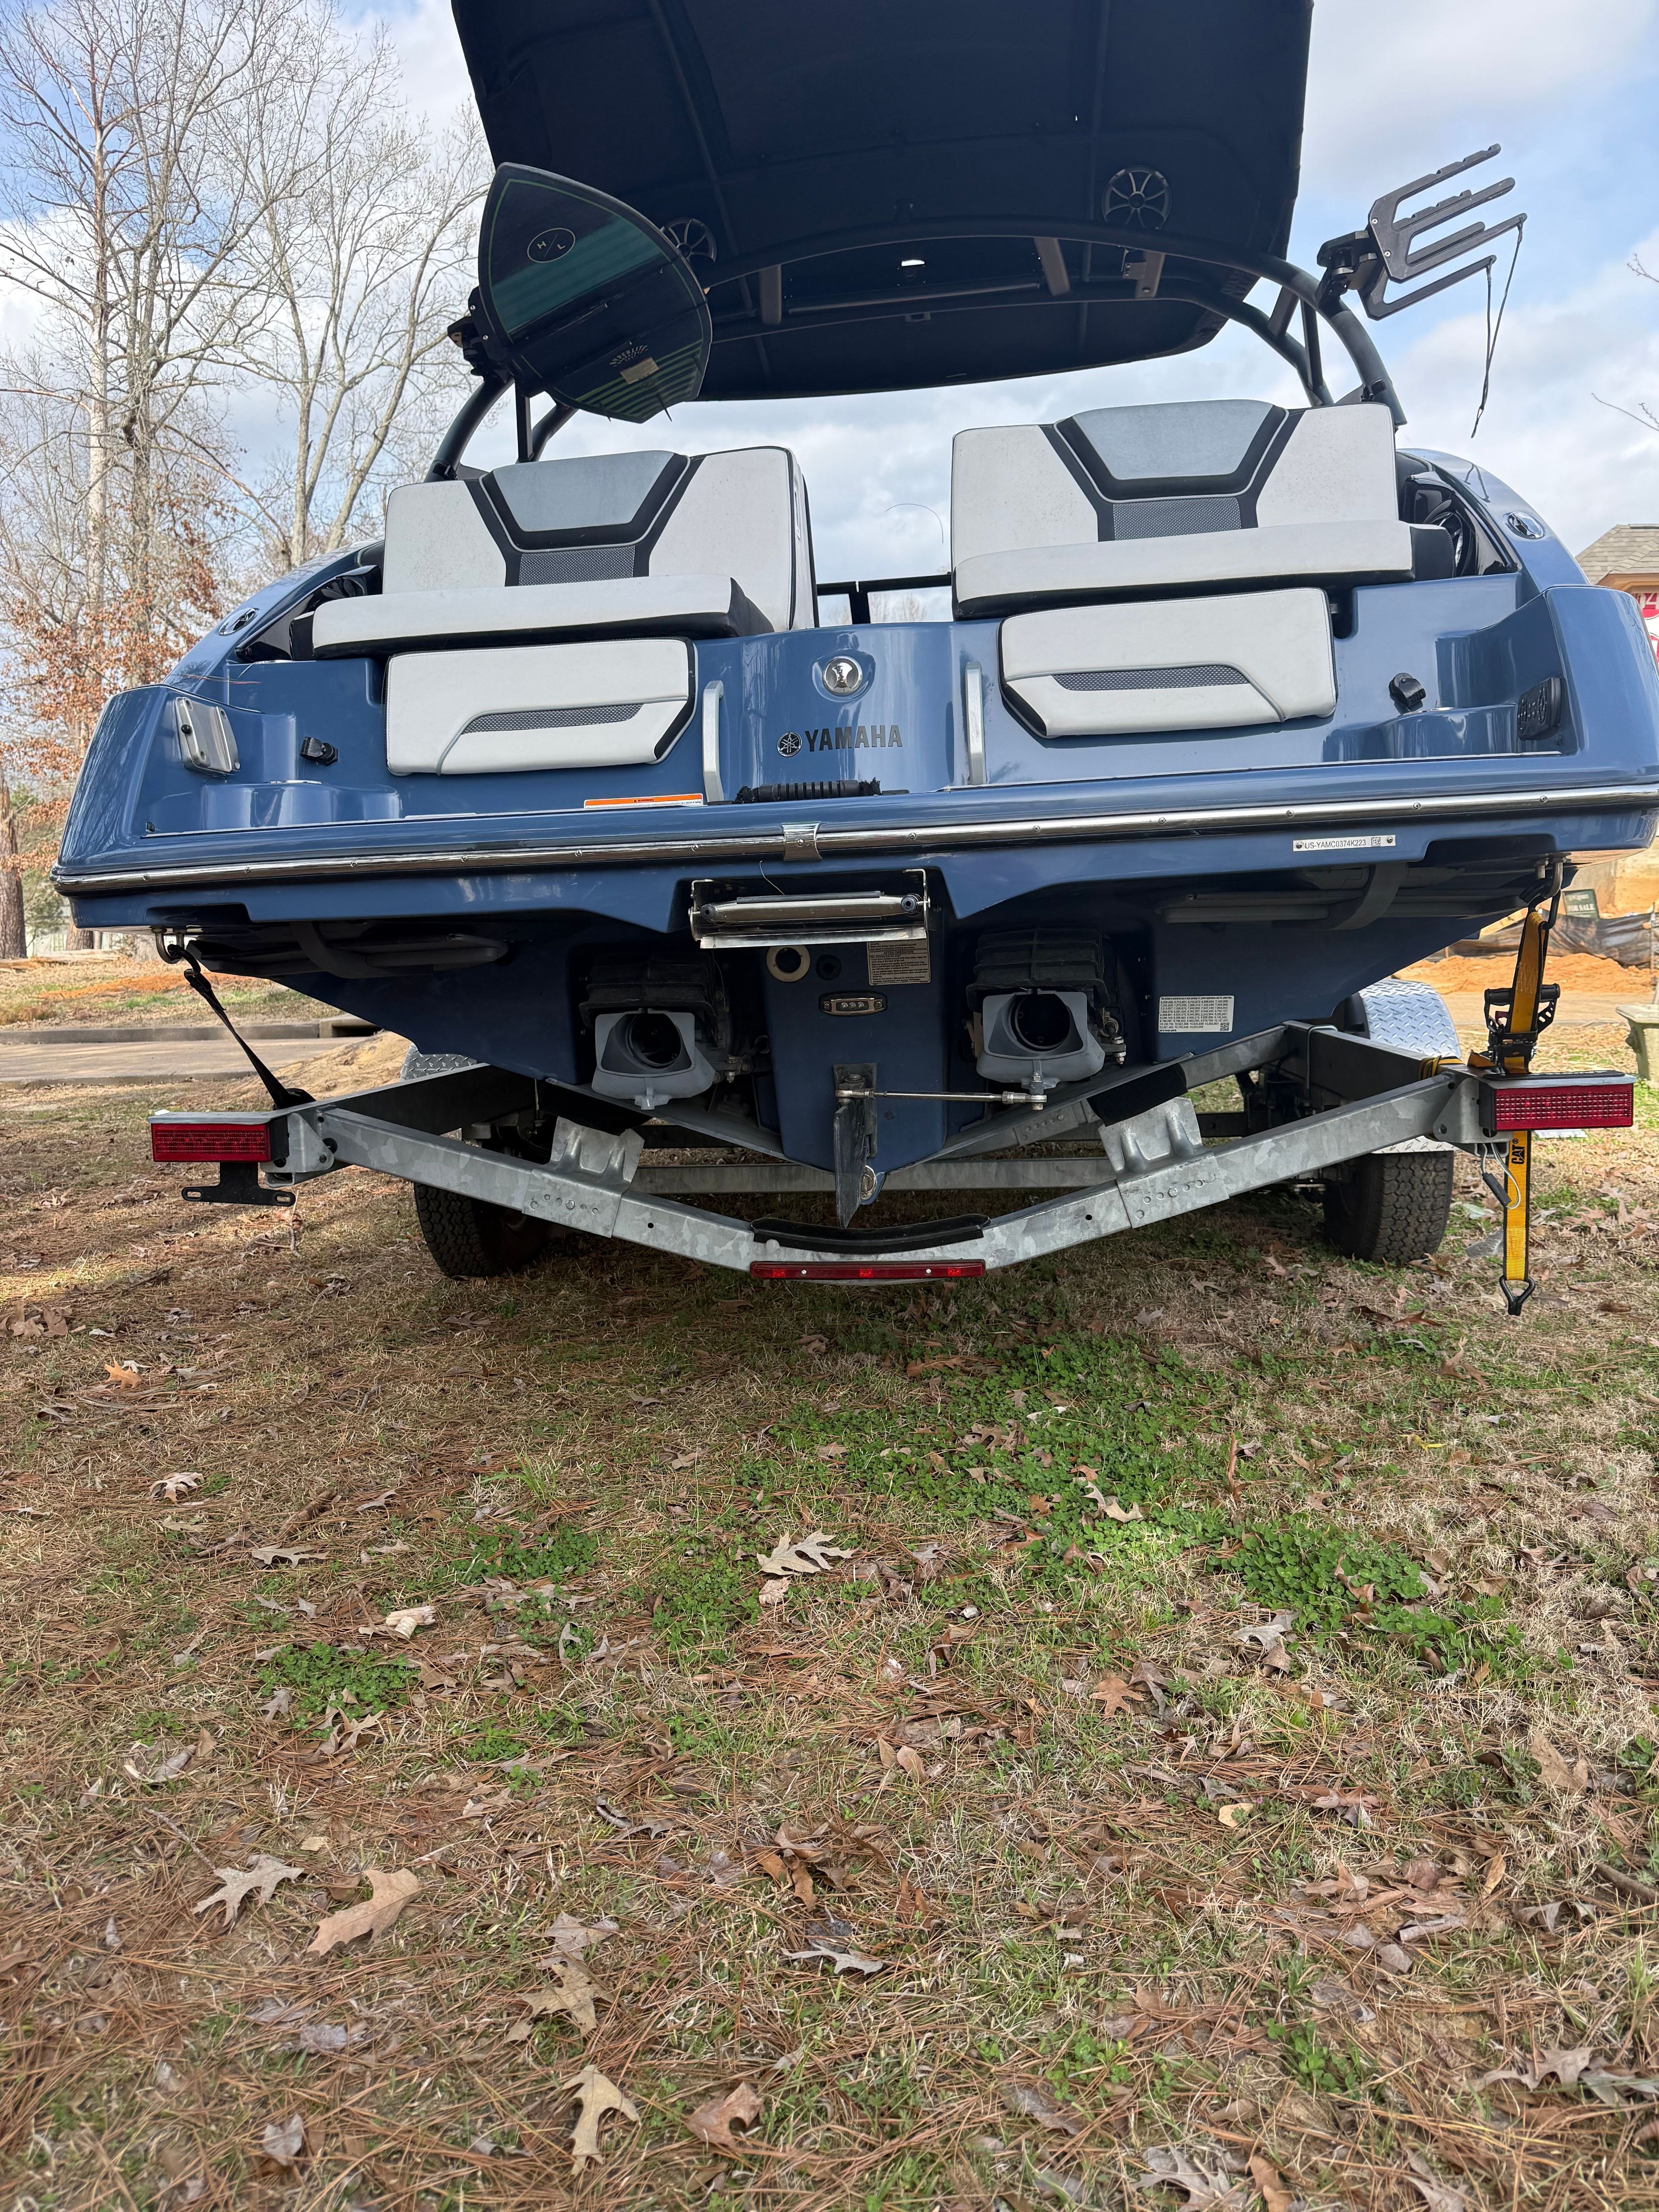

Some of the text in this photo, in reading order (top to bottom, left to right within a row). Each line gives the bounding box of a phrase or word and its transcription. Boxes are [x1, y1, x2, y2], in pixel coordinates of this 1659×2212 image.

[804, 725, 903, 752] YAMAHA
[1305, 839, 1366, 849] US-YAMC0374K223
[1511, 1144, 1525, 1164] CAT
